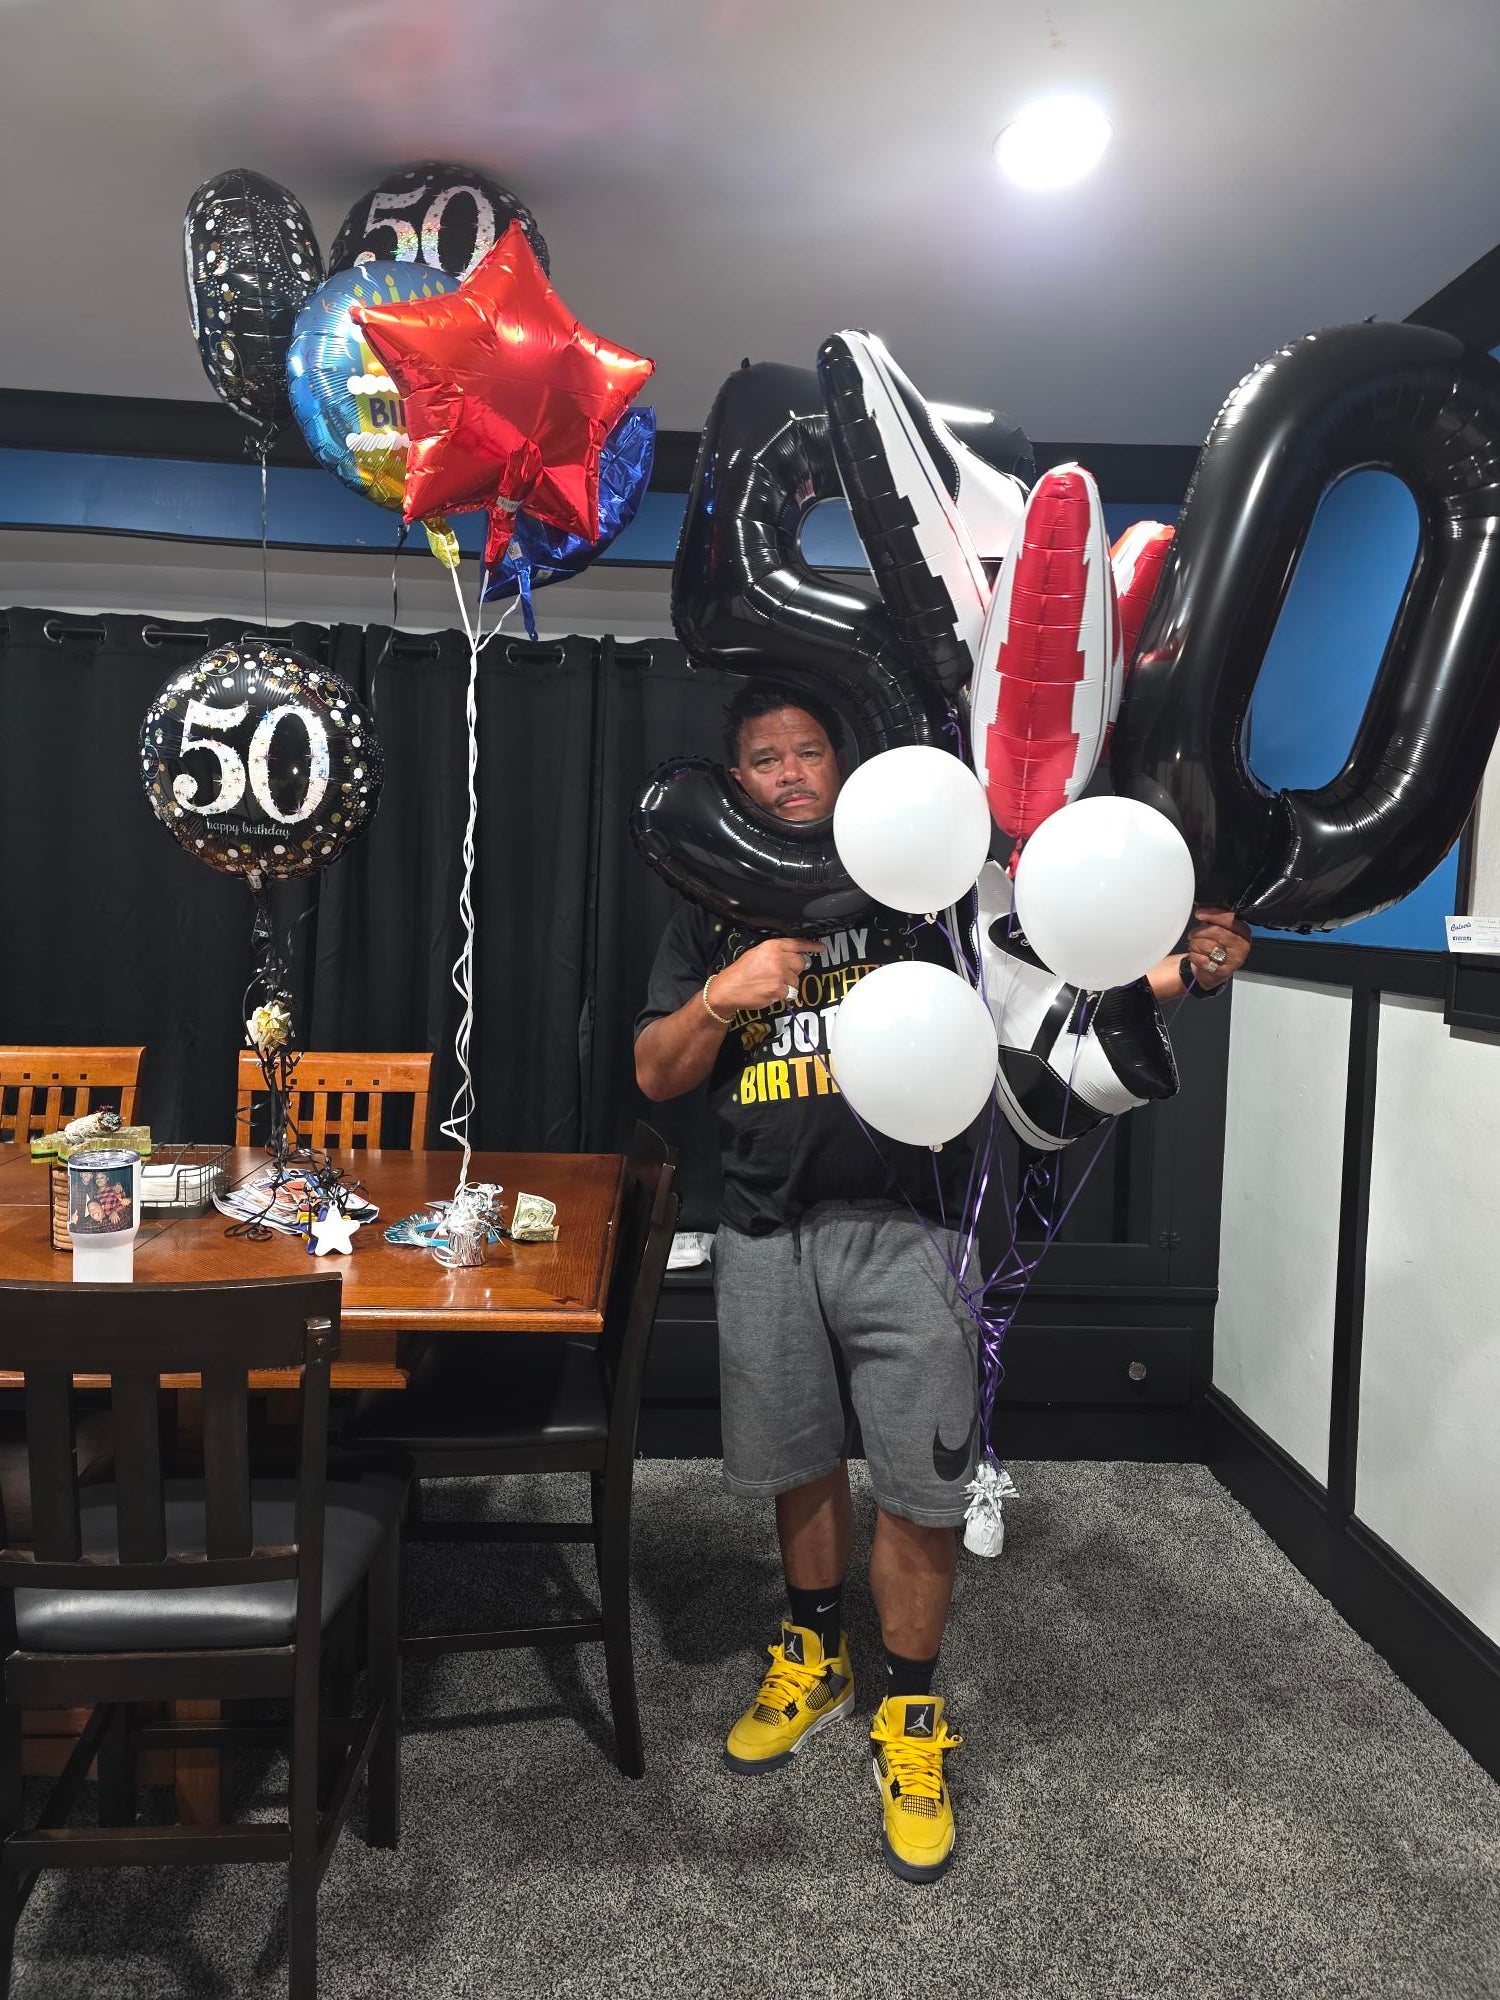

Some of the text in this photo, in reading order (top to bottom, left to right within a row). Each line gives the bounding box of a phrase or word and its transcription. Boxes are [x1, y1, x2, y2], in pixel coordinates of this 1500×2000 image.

[354, 184, 496, 281] 50
[172, 699, 330, 824] 50
[205, 817, 291, 840] happy birthday
[820, 928, 868, 968] MY
